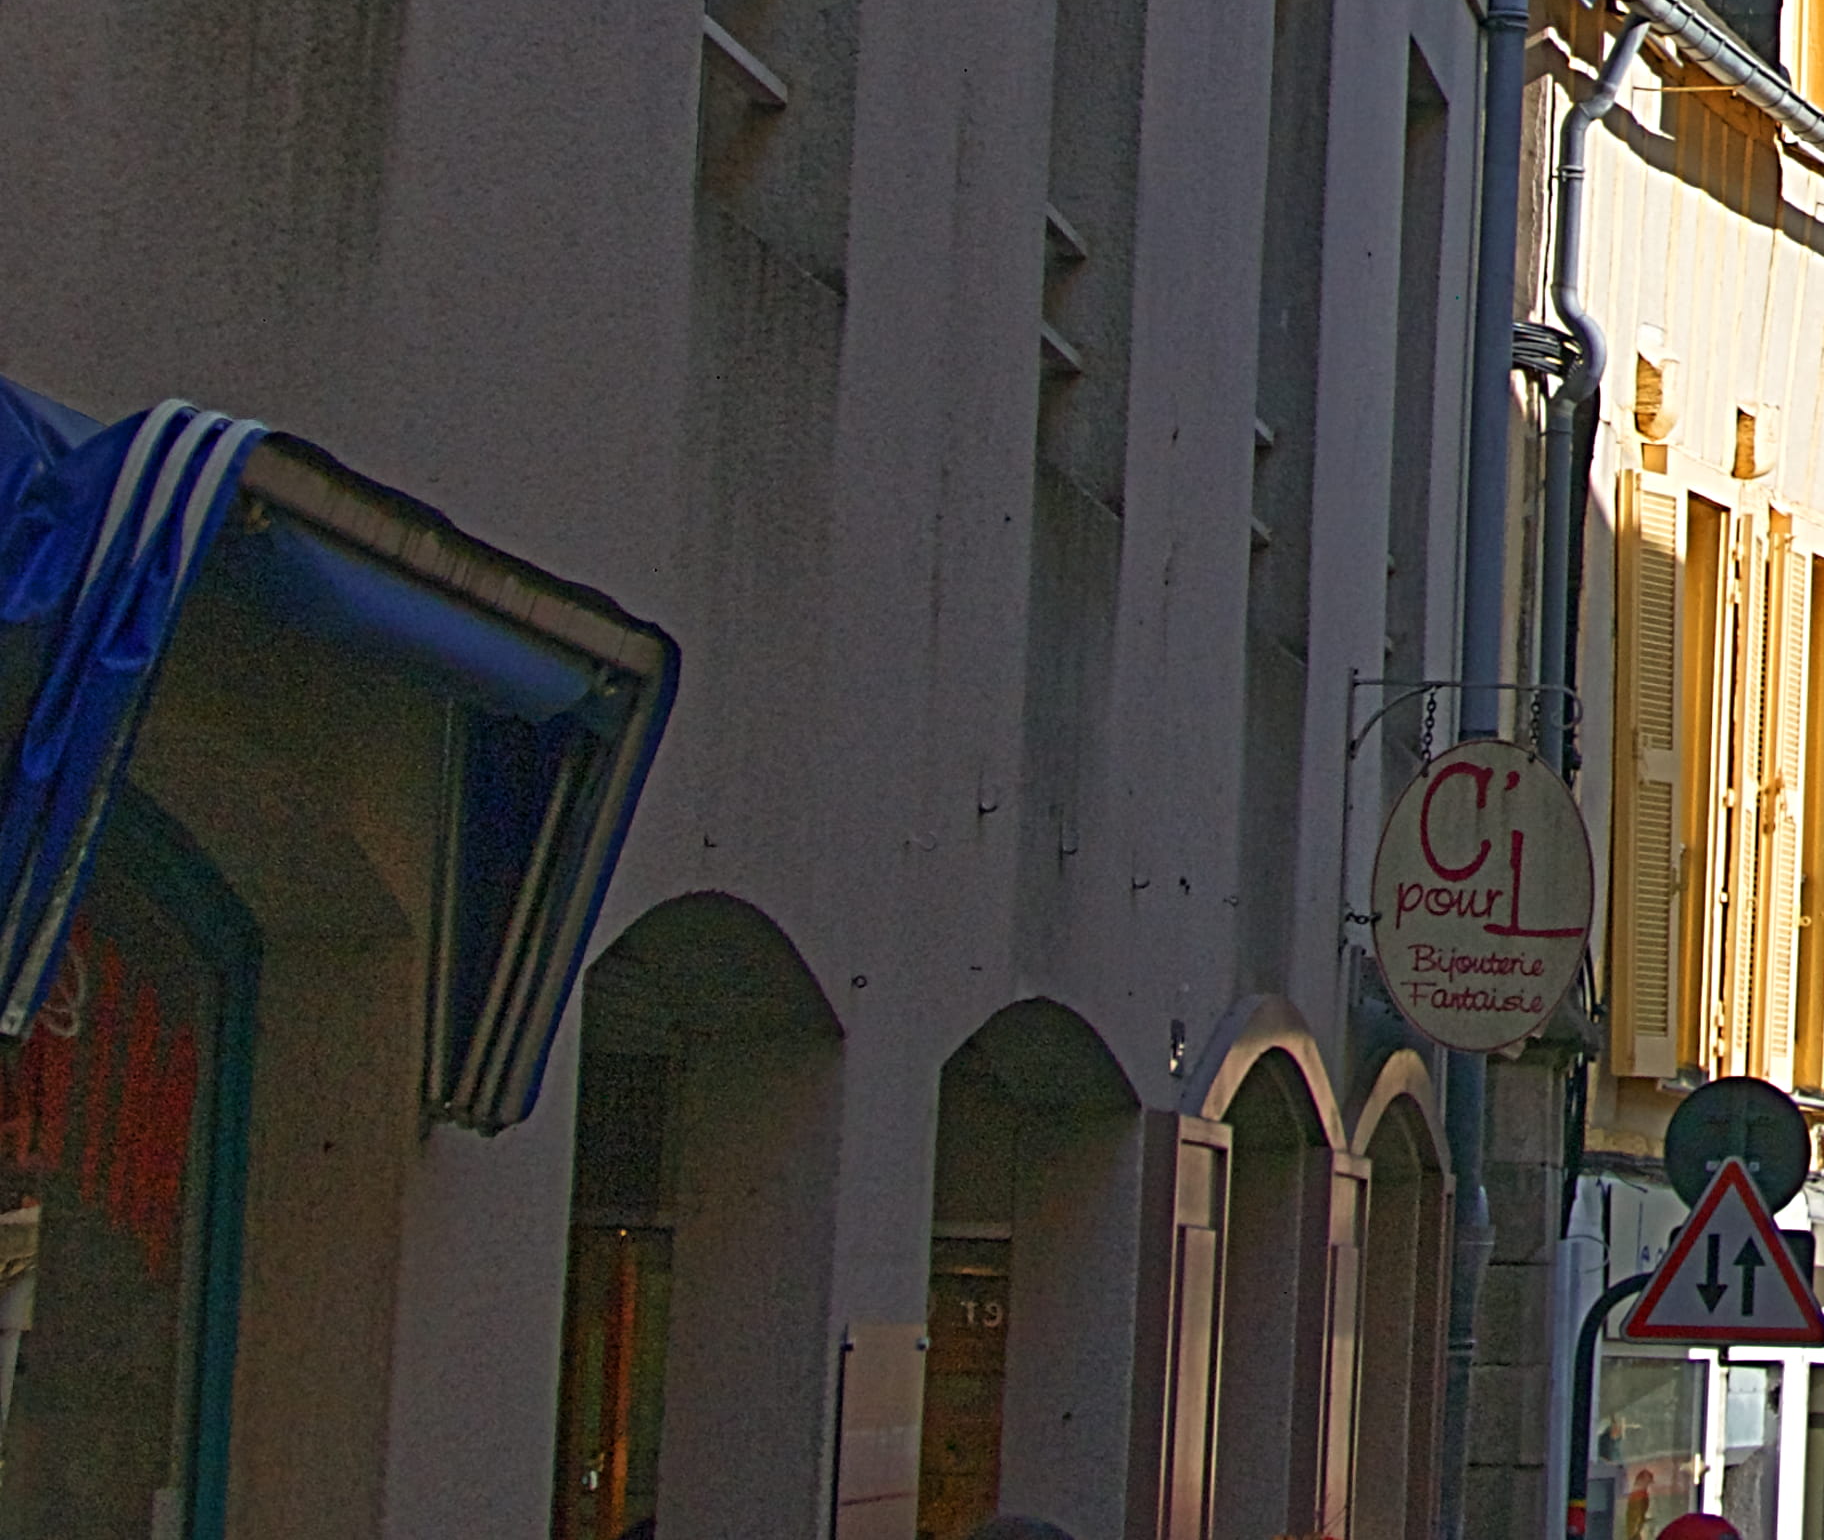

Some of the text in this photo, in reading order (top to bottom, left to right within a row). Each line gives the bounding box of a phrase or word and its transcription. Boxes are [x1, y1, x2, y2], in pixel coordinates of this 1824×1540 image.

[1395, 882, 1503, 931] pour
[1408, 943, 1545, 982] Bijouterie
[1400, 981, 1545, 1014] Fantaisie
